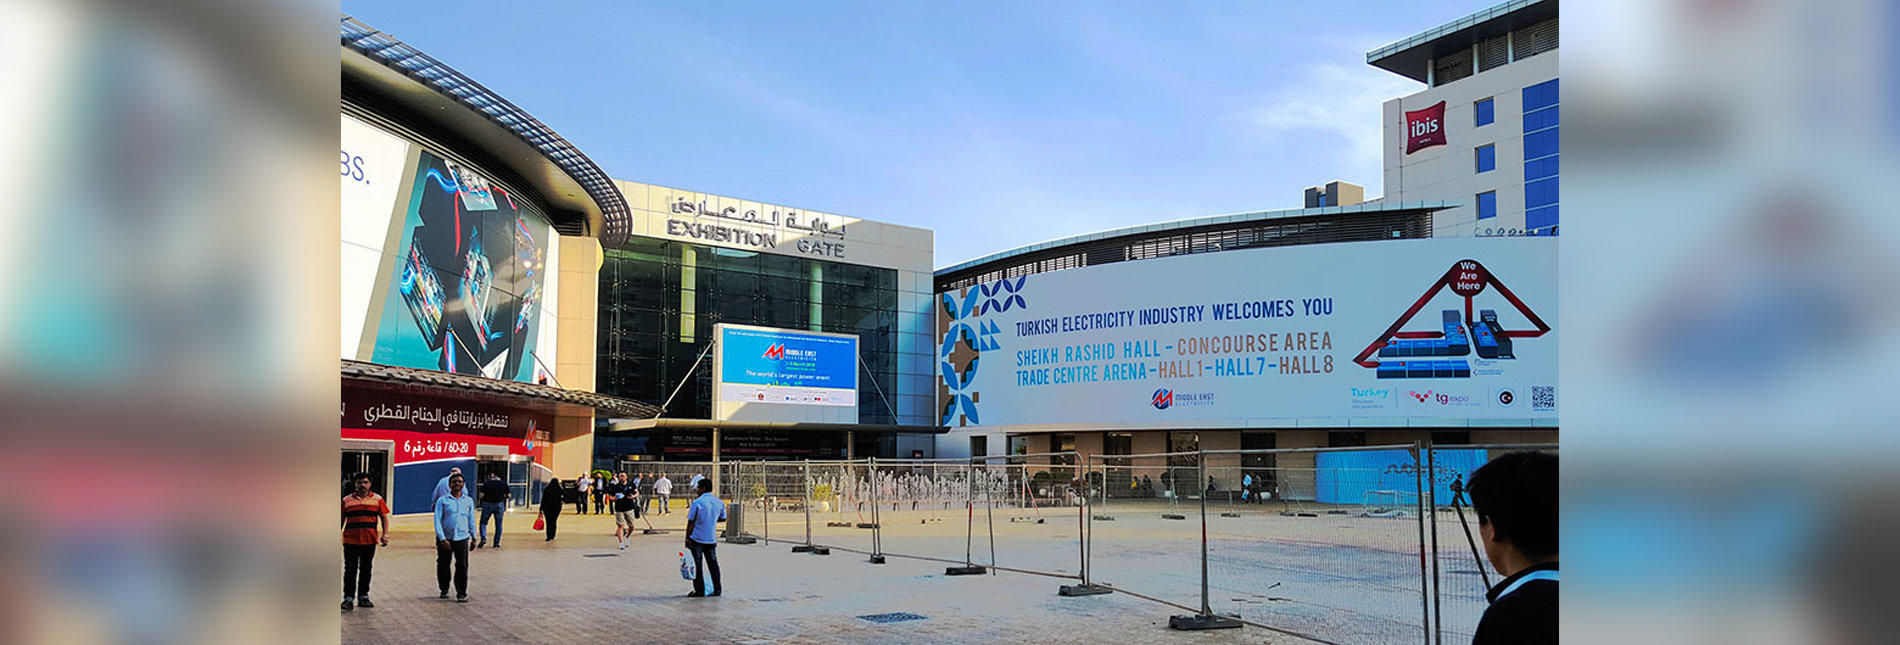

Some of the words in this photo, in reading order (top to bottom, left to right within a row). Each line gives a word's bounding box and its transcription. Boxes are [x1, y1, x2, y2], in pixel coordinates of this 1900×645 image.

[1411, 117, 1439, 138] ibis
[667, 219, 777, 249] EXHIBITION
[797, 238, 846, 259] GATE
[1460, 262, 1477, 270] We
[1459, 272, 1478, 280] Are
[1457, 282, 1481, 290] Here
[1016, 318, 1058, 337] TURKISH
[1062, 310, 1135, 333] ELECTRICITY
[1139, 305, 1205, 326] INDUSTRY
[1212, 299, 1295, 321] WELCOMES
[1302, 297, 1333, 316] YOU
[1016, 347, 1059, 367] SHEIKH
[1065, 342, 1115, 362] RASHID
[1123, 340, 1161, 359] HALL
[1177, 333, 1279, 356] CONCOURSE
[1284, 331, 1332, 351] AREA
[745, 369, 756, 377] The
[779, 372, 798, 380] largest
[1016, 368, 1050, 387] TRADE
[1053, 365, 1099, 384] CENTRE
[1199, 392, 1214, 401] EAST
[1350, 387, 1390, 399] Turkey
[1435, 392, 1448, 405] tg
[363, 402, 411, 427] القطري
[410, 404, 442, 426] الجناح
[441, 410, 459, 431] في
[403, 439, 411, 453] 6
